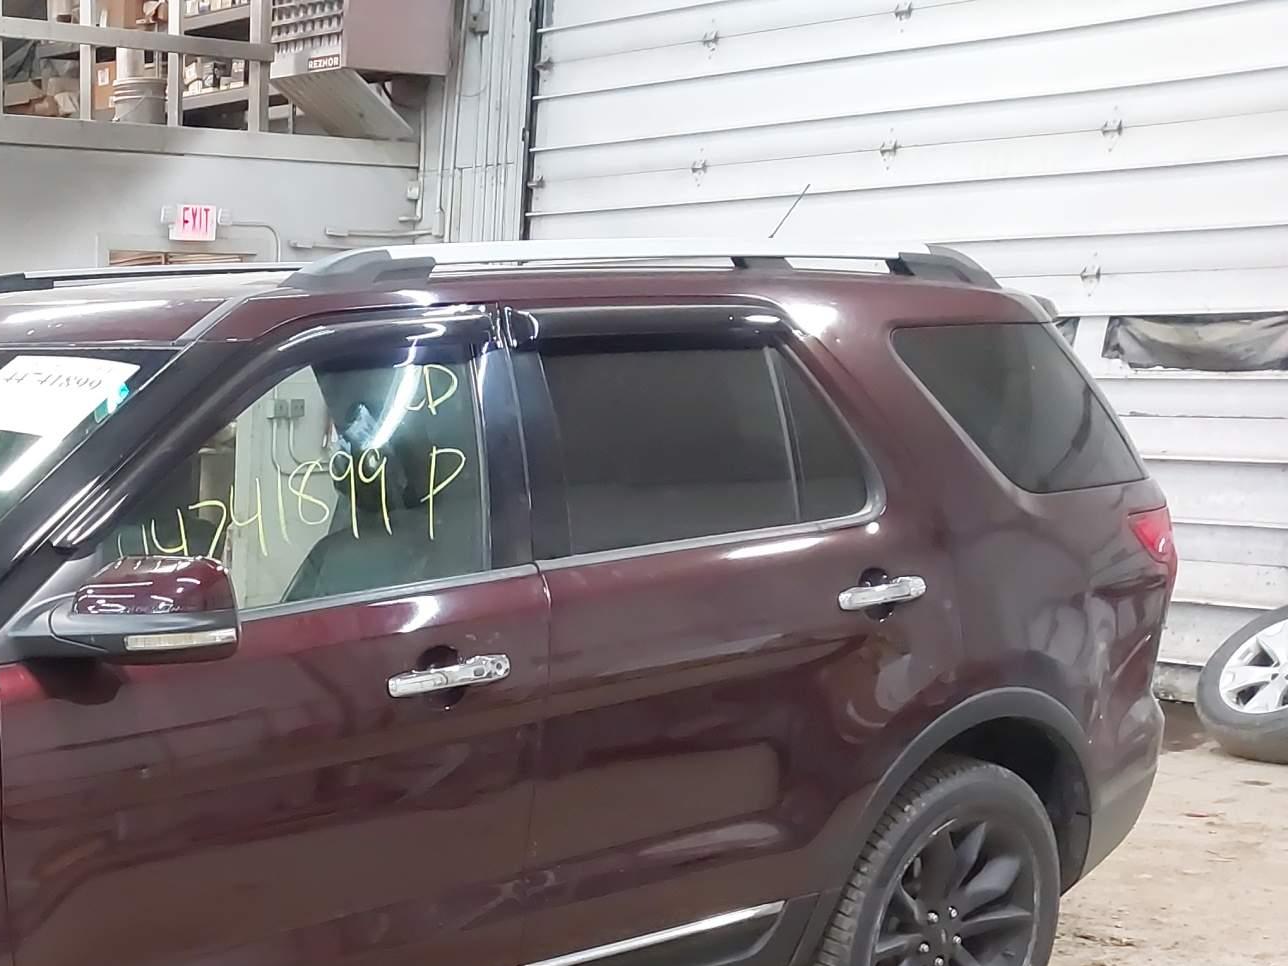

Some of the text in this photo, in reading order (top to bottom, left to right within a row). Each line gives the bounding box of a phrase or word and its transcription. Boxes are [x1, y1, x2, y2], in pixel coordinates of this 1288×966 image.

[308, 56, 340, 69] REZNOR
[182, 206, 211, 232] EXIT
[419, 445, 466, 541] P
